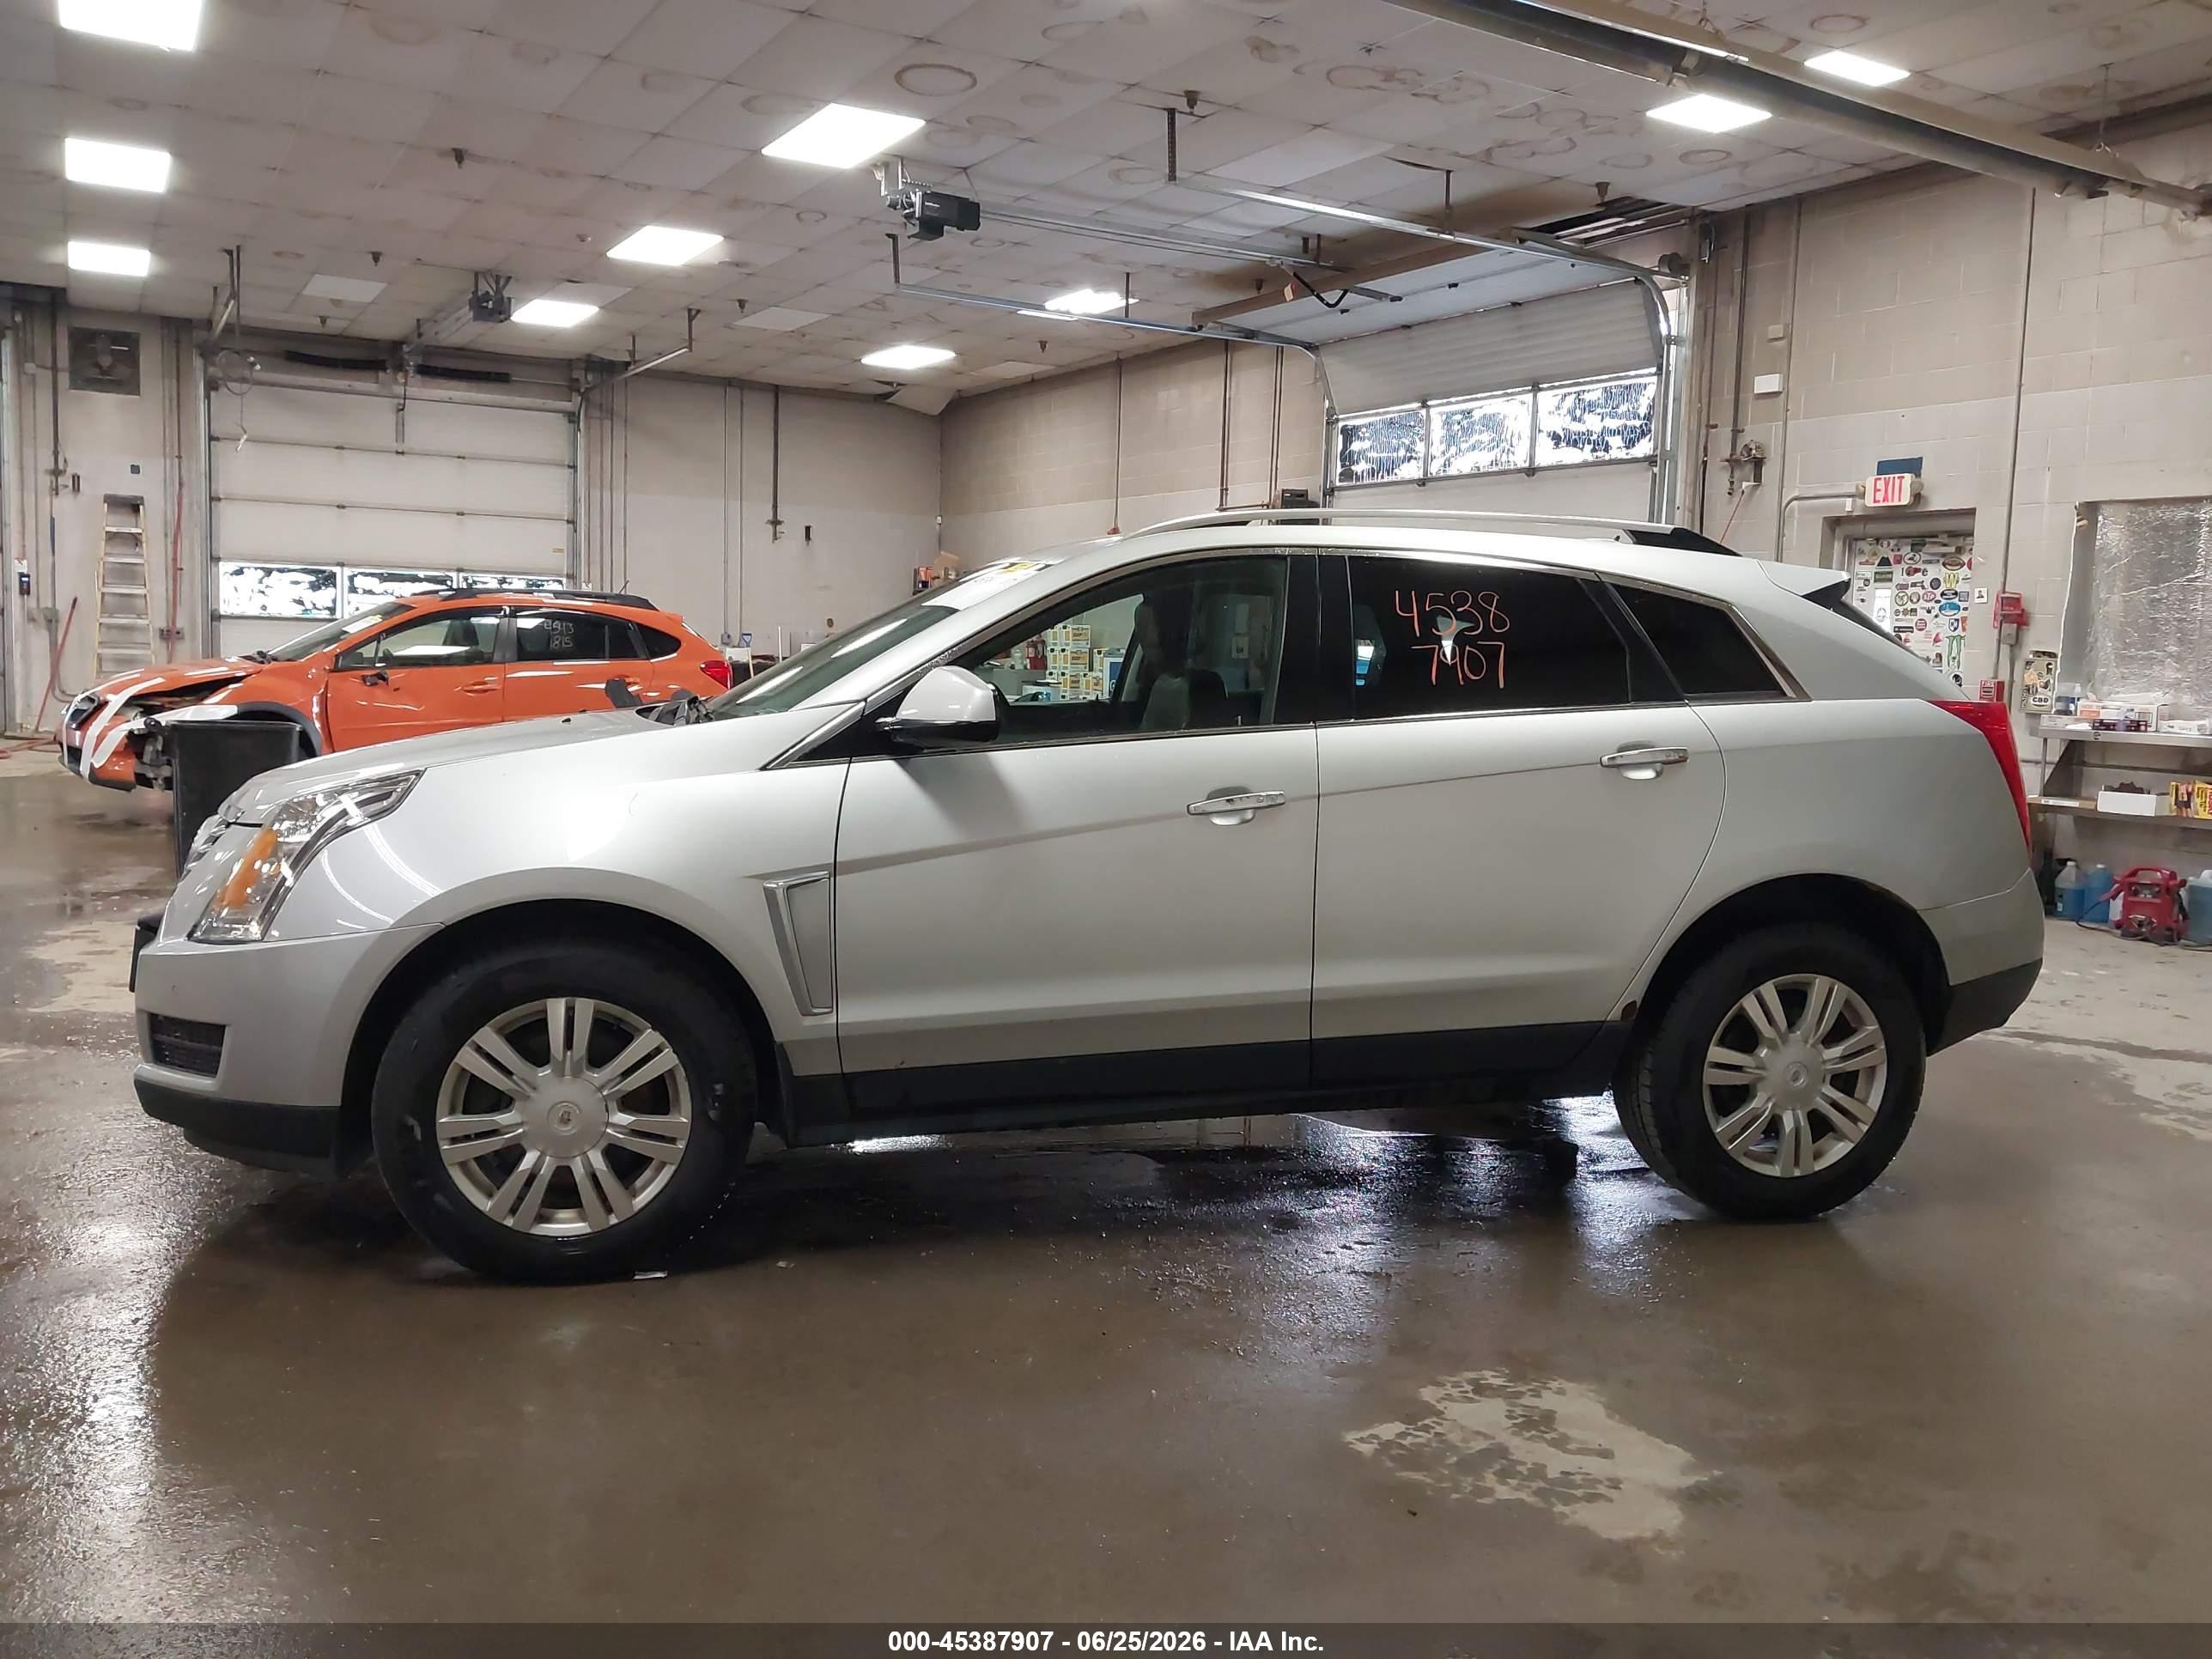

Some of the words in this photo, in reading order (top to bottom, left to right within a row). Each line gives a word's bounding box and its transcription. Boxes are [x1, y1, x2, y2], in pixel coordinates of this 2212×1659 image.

[1873, 475, 1905, 504] EXIT
[1395, 590, 1510, 638] 4538
[1411, 641, 1505, 689] 7907
